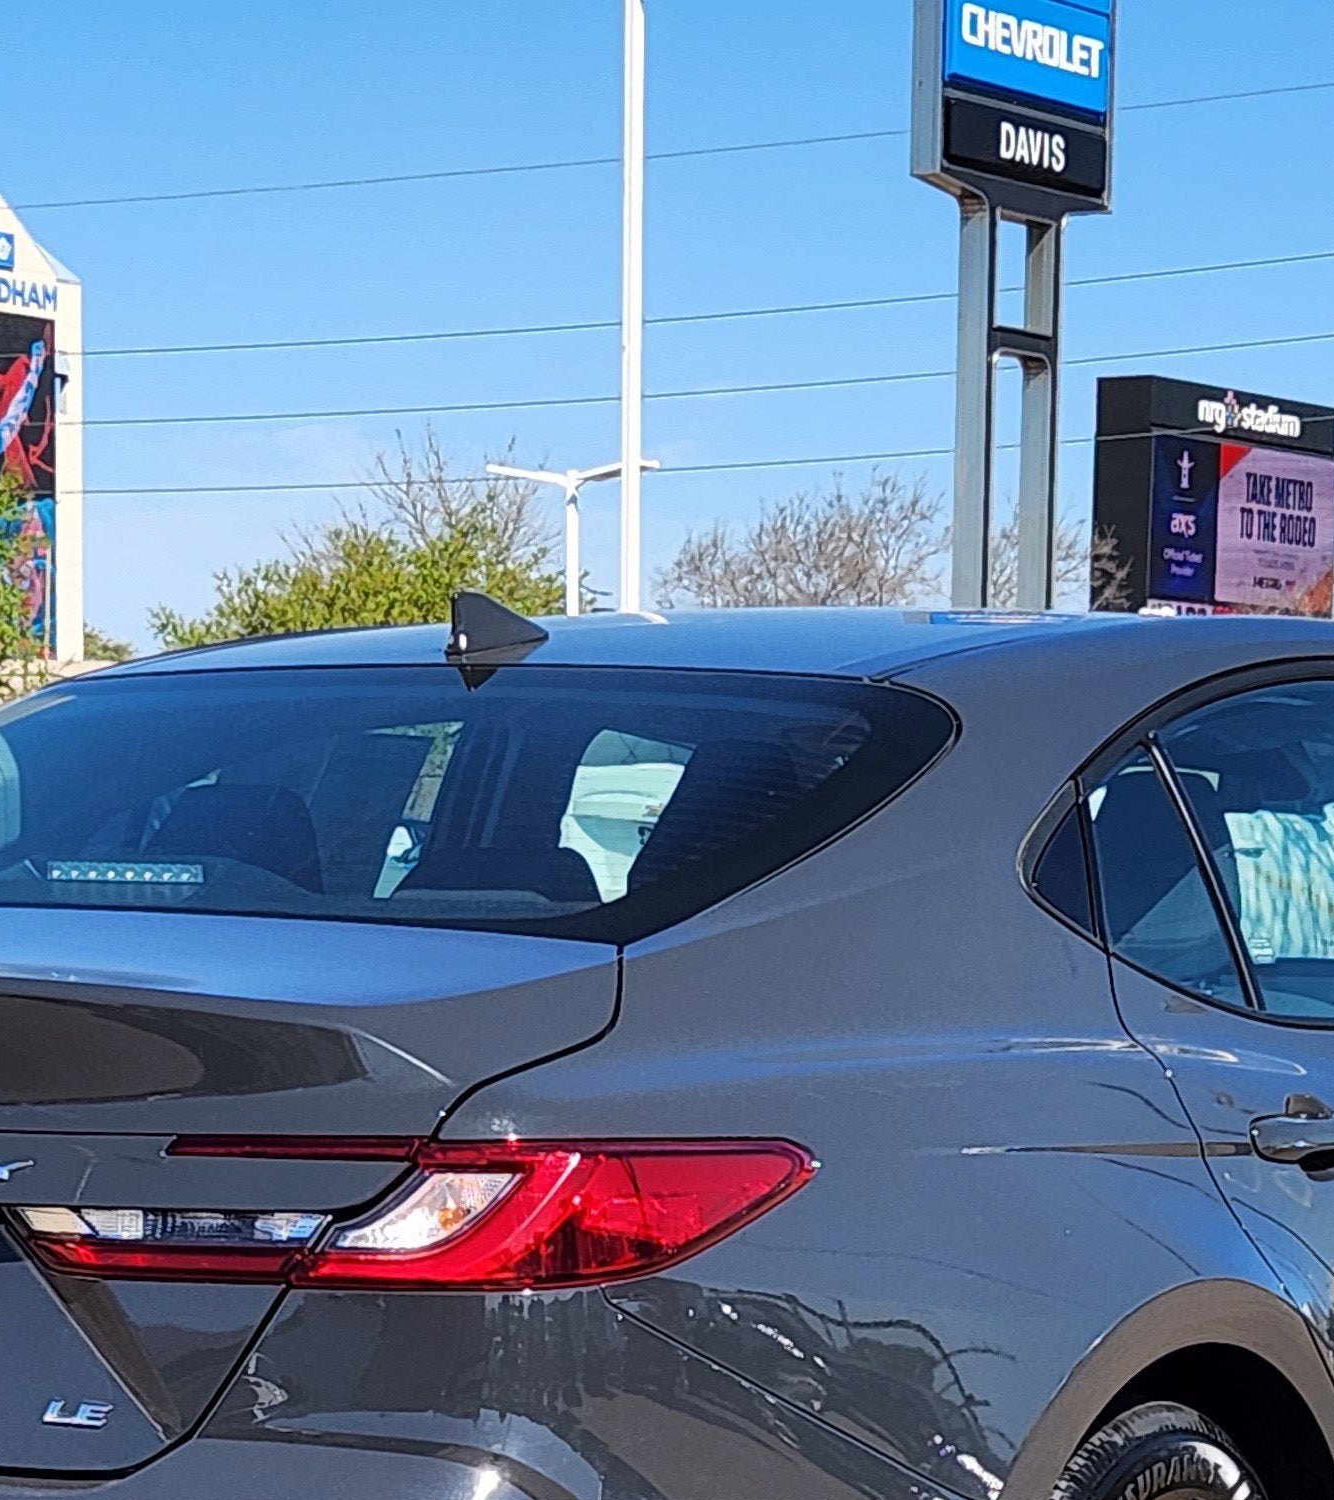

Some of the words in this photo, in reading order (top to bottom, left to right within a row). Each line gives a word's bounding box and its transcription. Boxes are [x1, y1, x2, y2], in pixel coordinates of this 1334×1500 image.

[962, 3, 1104, 78] CHEVROLET
[1000, 121, 1065, 172] DAVIS
[1198, 400, 1226, 433] nrg
[1240, 403, 1300, 438] stadium
[1246, 472, 1272, 506] TAKE
[1274, 476, 1313, 512] METRO
[1170, 513, 1196, 538] axs
[1240, 507, 1254, 539] TO
[1257, 509, 1277, 543] THE
[1279, 513, 1316, 548] RODEO
[42, 1400, 114, 1427] LE
